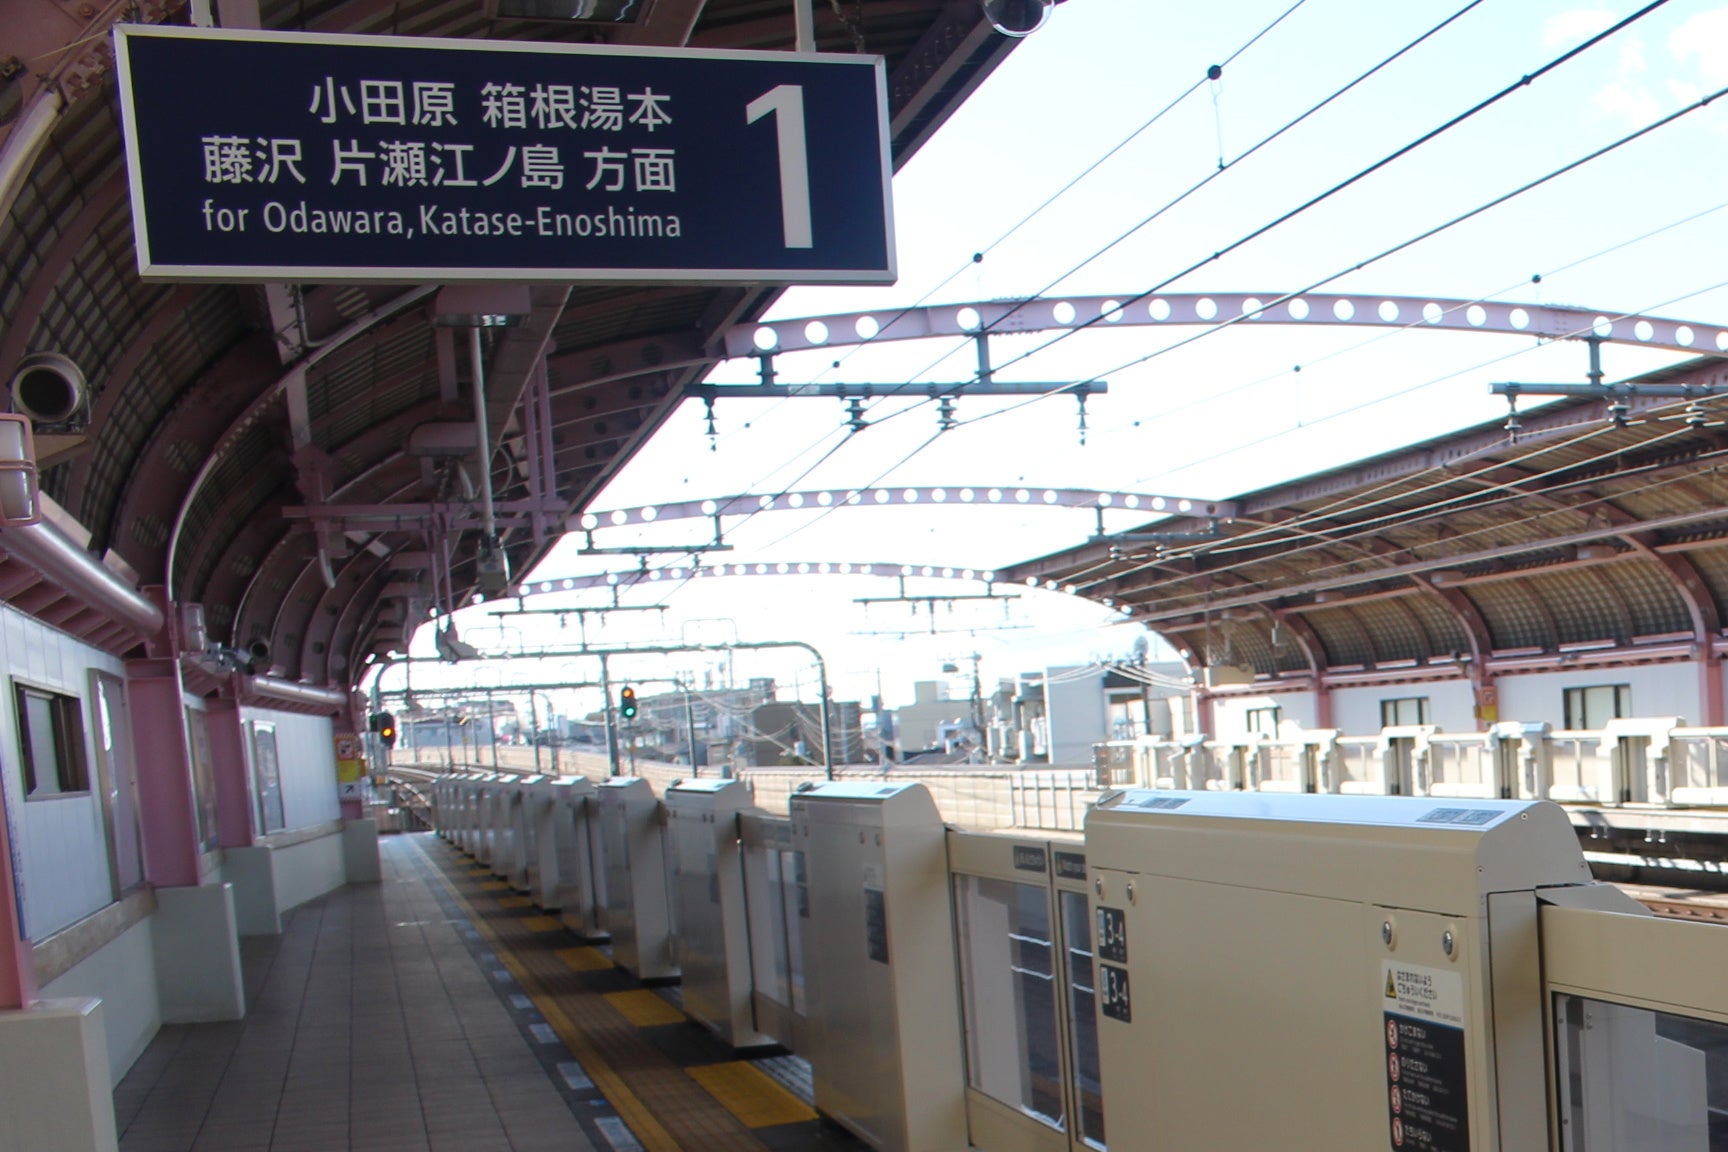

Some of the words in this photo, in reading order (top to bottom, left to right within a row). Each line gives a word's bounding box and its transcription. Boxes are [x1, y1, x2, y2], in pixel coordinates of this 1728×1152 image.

[308, 76, 457, 127] 小田原
[481, 80, 673, 133] 箱根湯本
[201, 136, 303, 186] 藤沢
[329, 139, 565, 192] 片瀬江ノ島
[584, 147, 678, 194] 方面
[745, 84, 814, 249] 1
[202, 199, 249, 233] for
